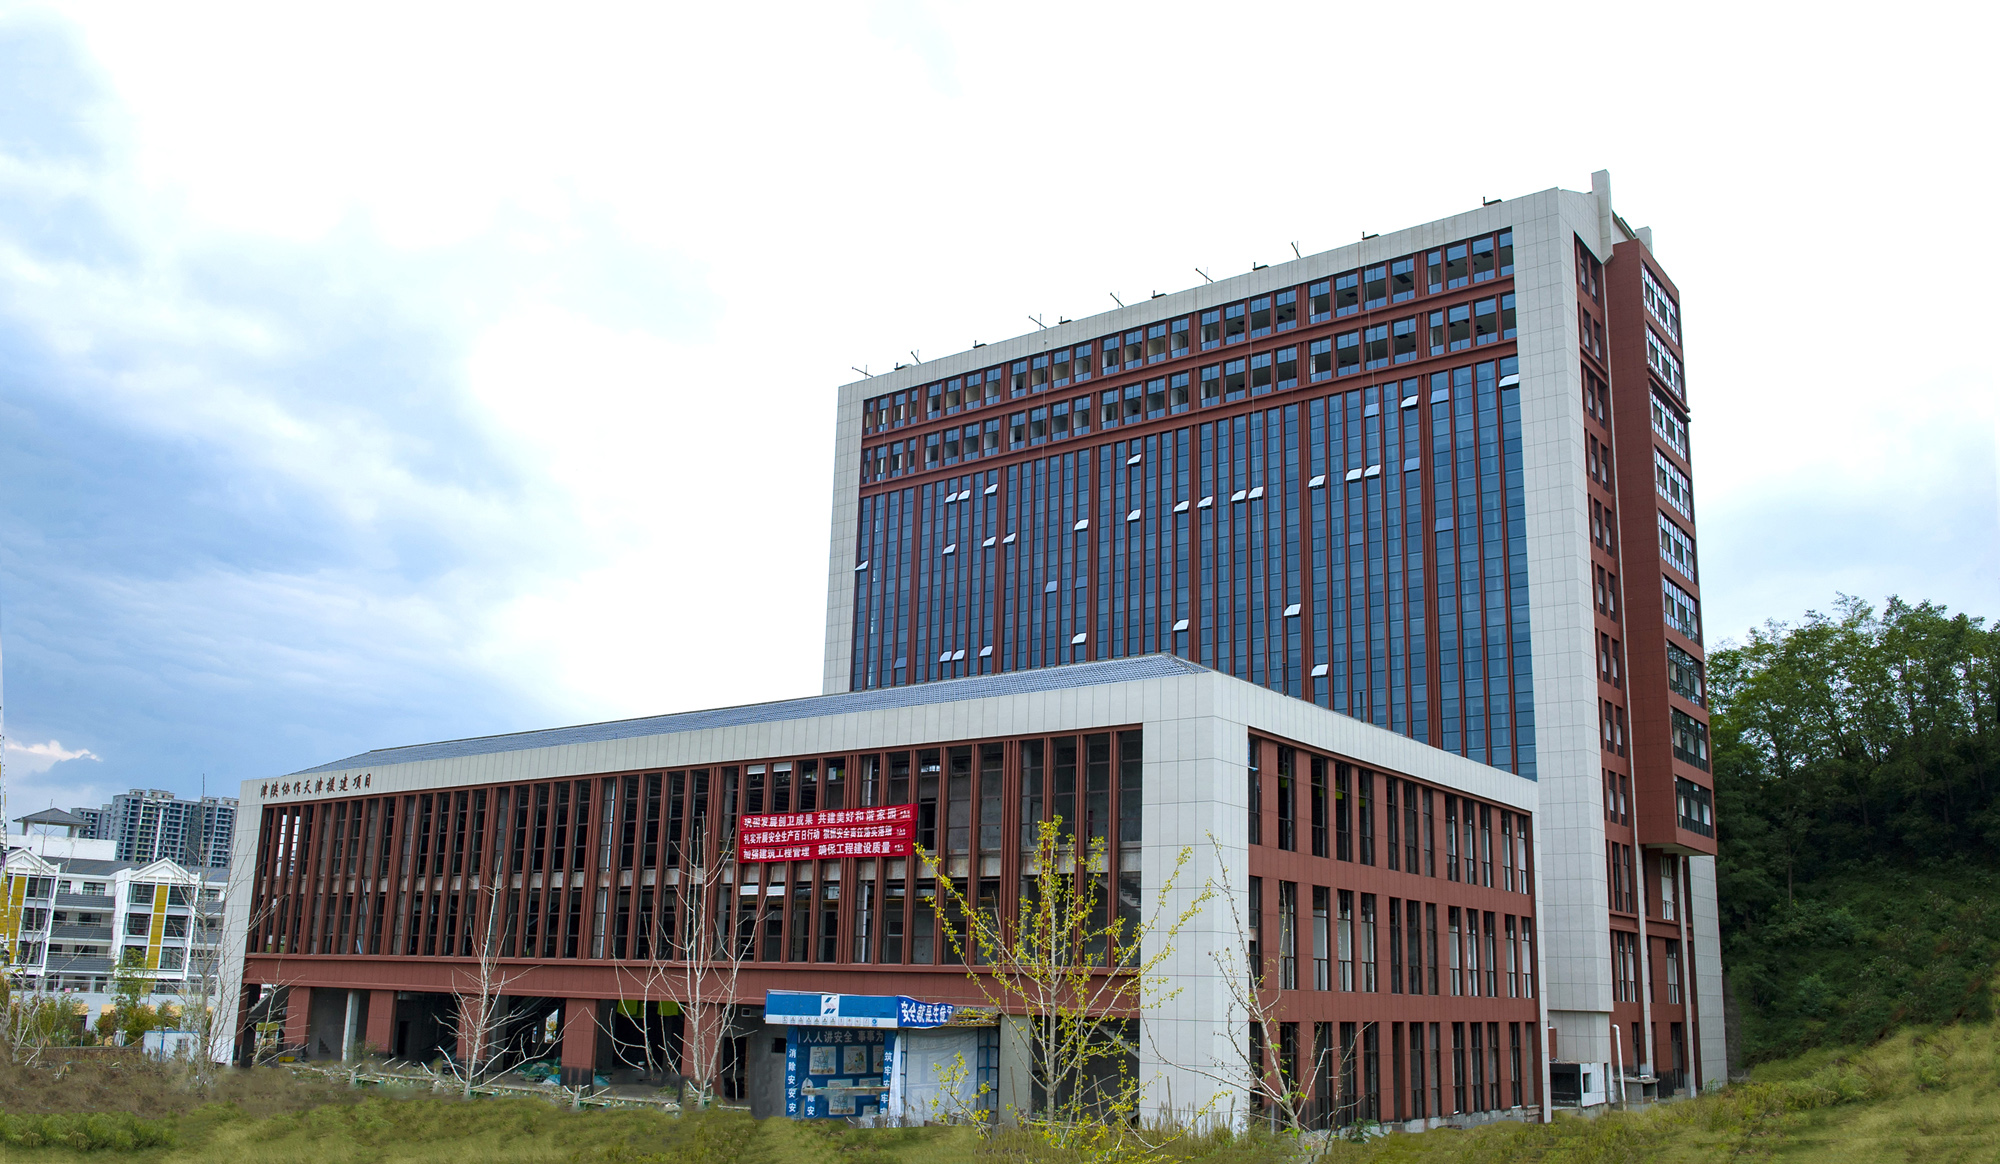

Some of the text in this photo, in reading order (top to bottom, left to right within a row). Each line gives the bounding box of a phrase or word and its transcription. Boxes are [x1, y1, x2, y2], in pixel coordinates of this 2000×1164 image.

[260, 773, 371, 799] 津陕协作天津援建项目
[743, 846, 810, 860] 加强建筑工程管理
[818, 841, 890, 856] 确保工程建设质量
[803, 1030, 853, 1044] 人人讲安全
